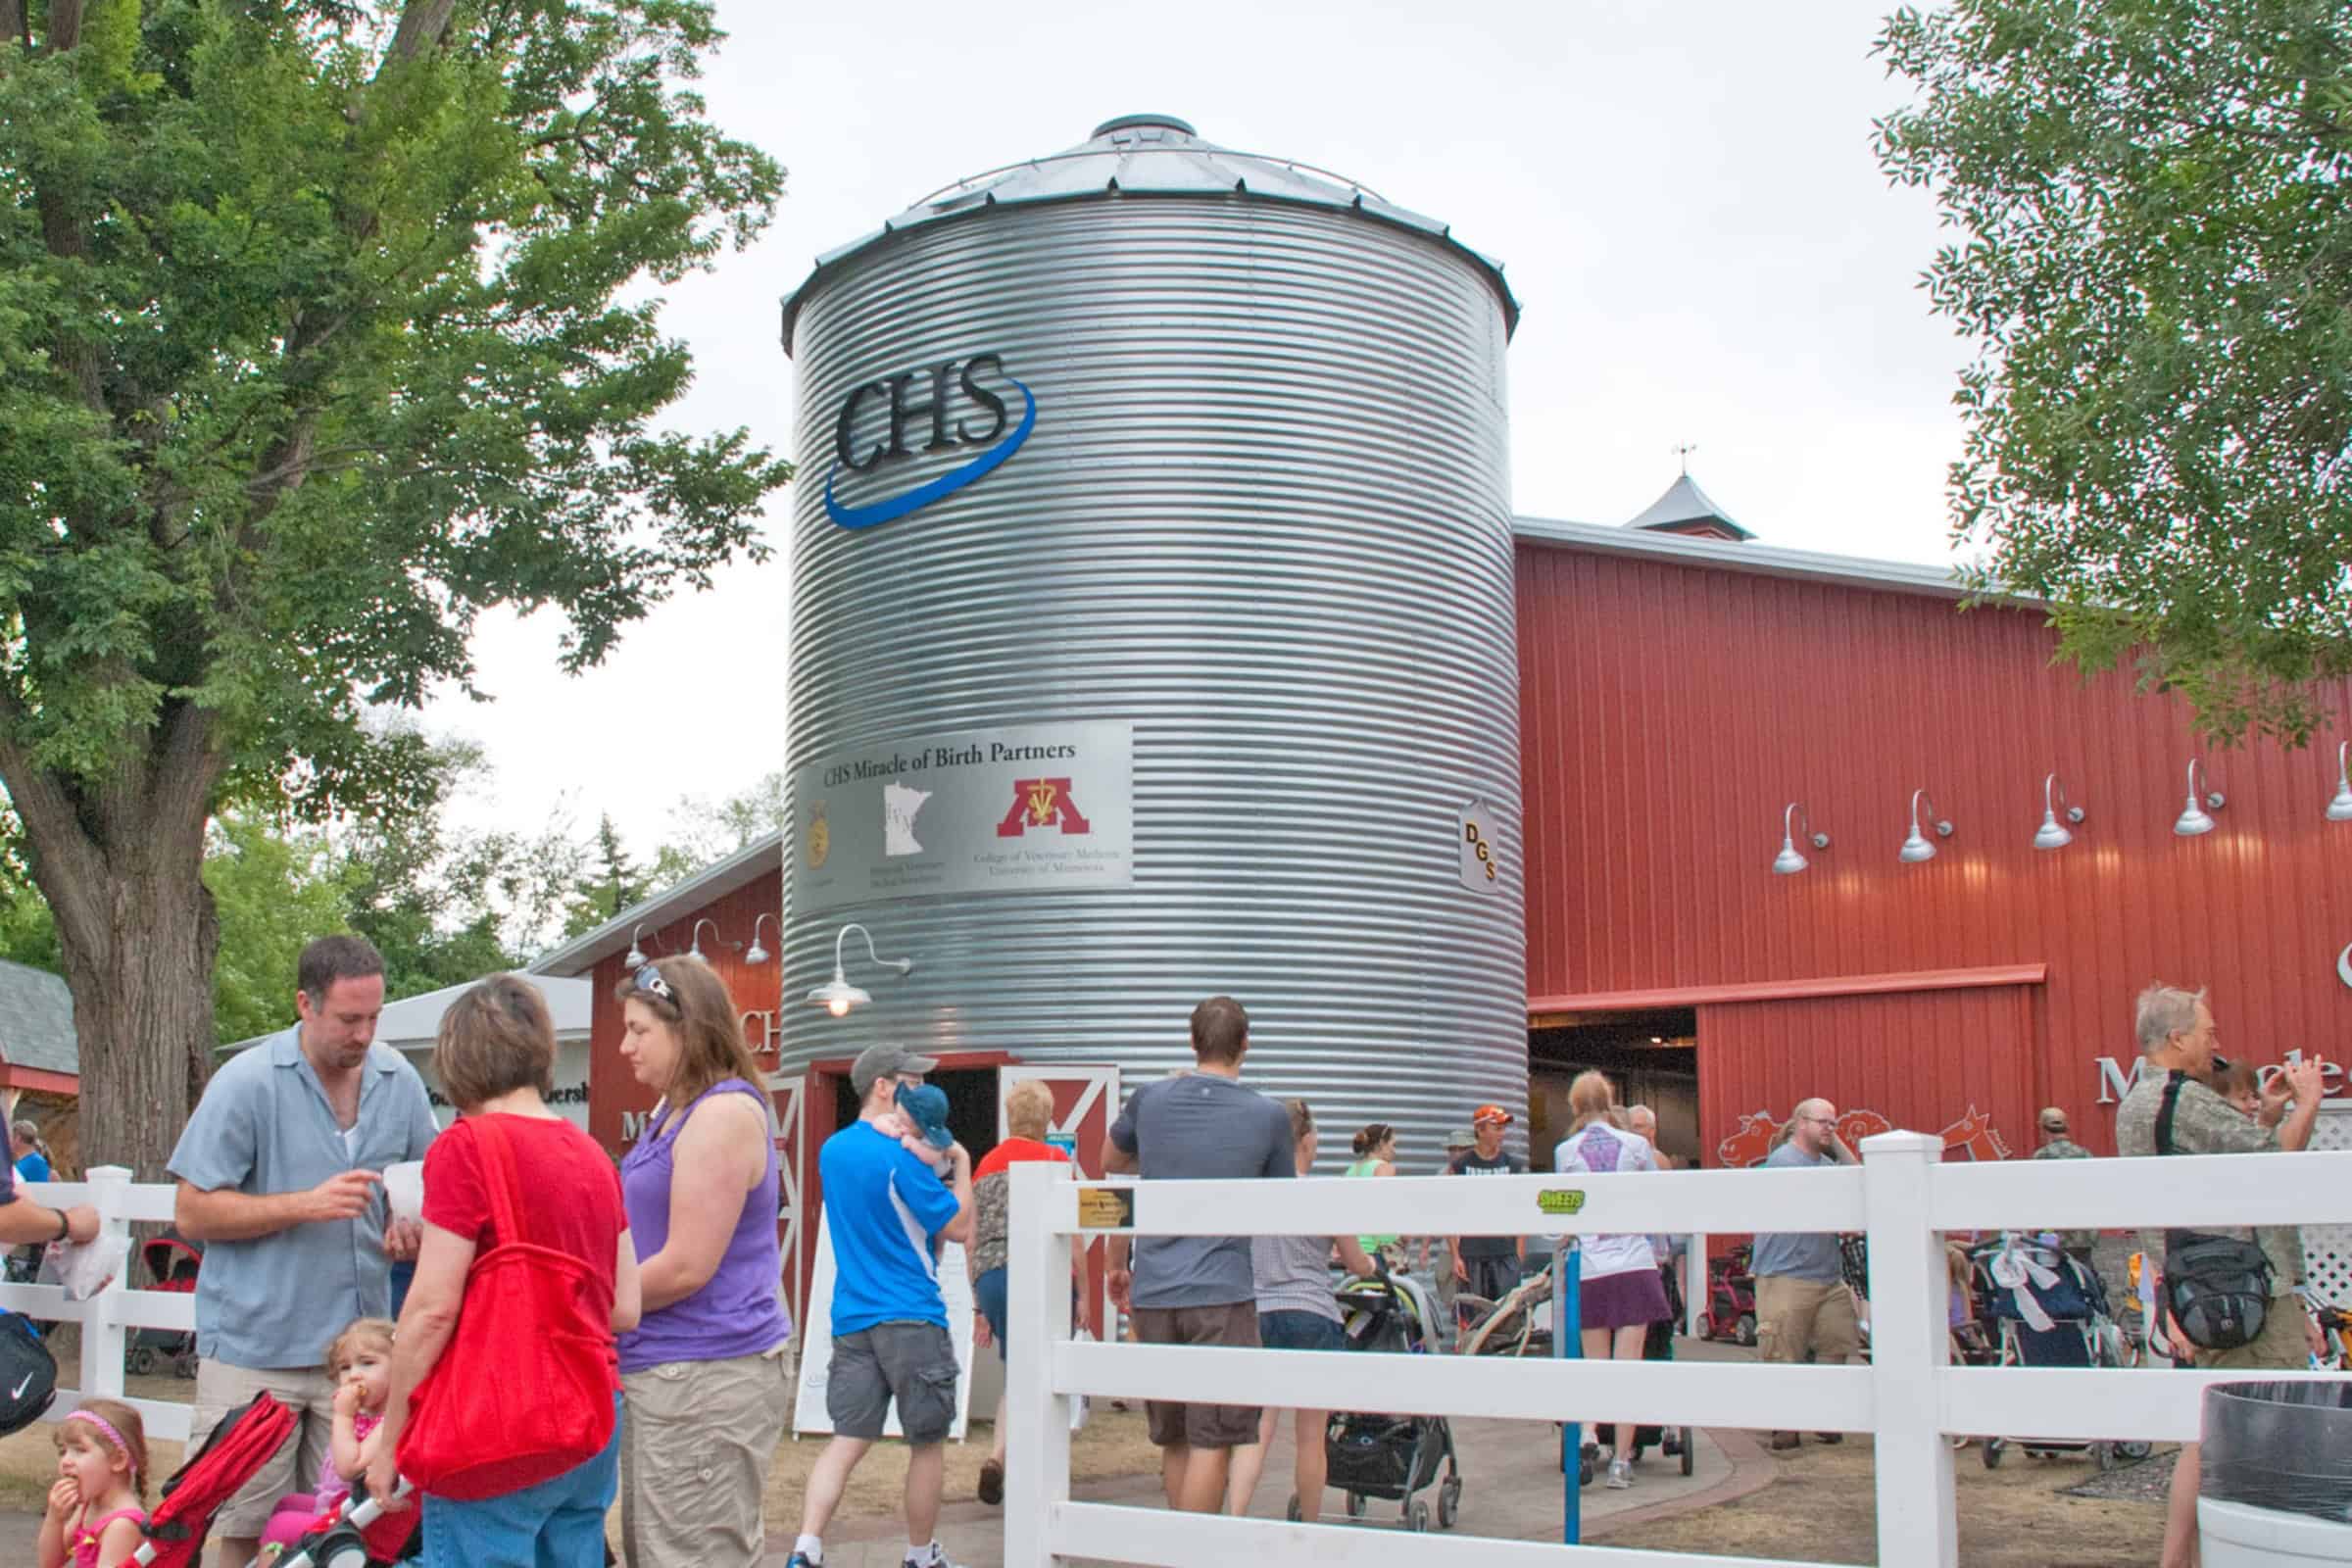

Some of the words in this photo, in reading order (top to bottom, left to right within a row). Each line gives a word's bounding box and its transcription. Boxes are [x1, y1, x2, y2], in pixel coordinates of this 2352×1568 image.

[837, 353, 1006, 469] CHS
[823, 763, 851, 788] CHS
[855, 753, 907, 781] Miracle
[912, 748, 932, 769] of
[936, 744, 983, 767] Birth
[990, 742, 1076, 762] Partners
